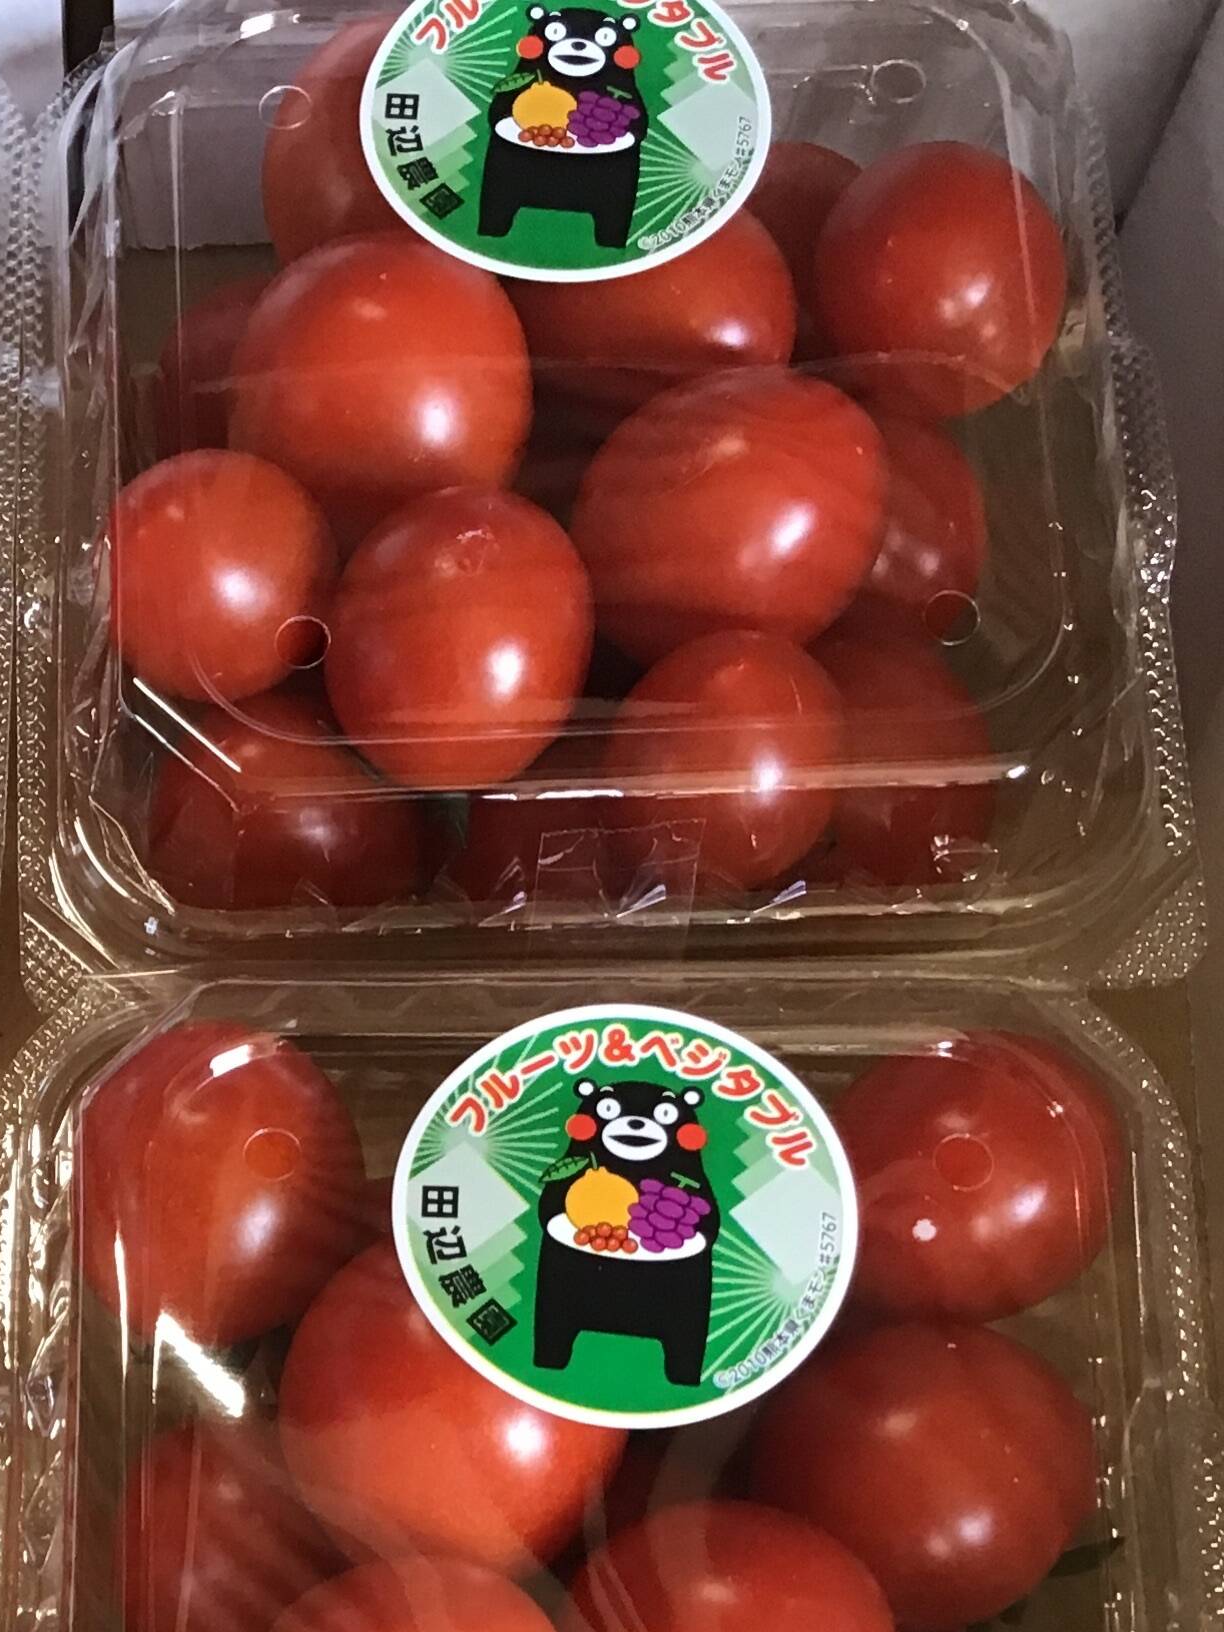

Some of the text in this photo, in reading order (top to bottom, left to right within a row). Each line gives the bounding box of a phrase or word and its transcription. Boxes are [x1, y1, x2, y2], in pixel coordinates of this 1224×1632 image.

[450, 1027, 814, 1166] フルーツ&ベジタブル
[421, 1185, 518, 1346] 田辺農園
